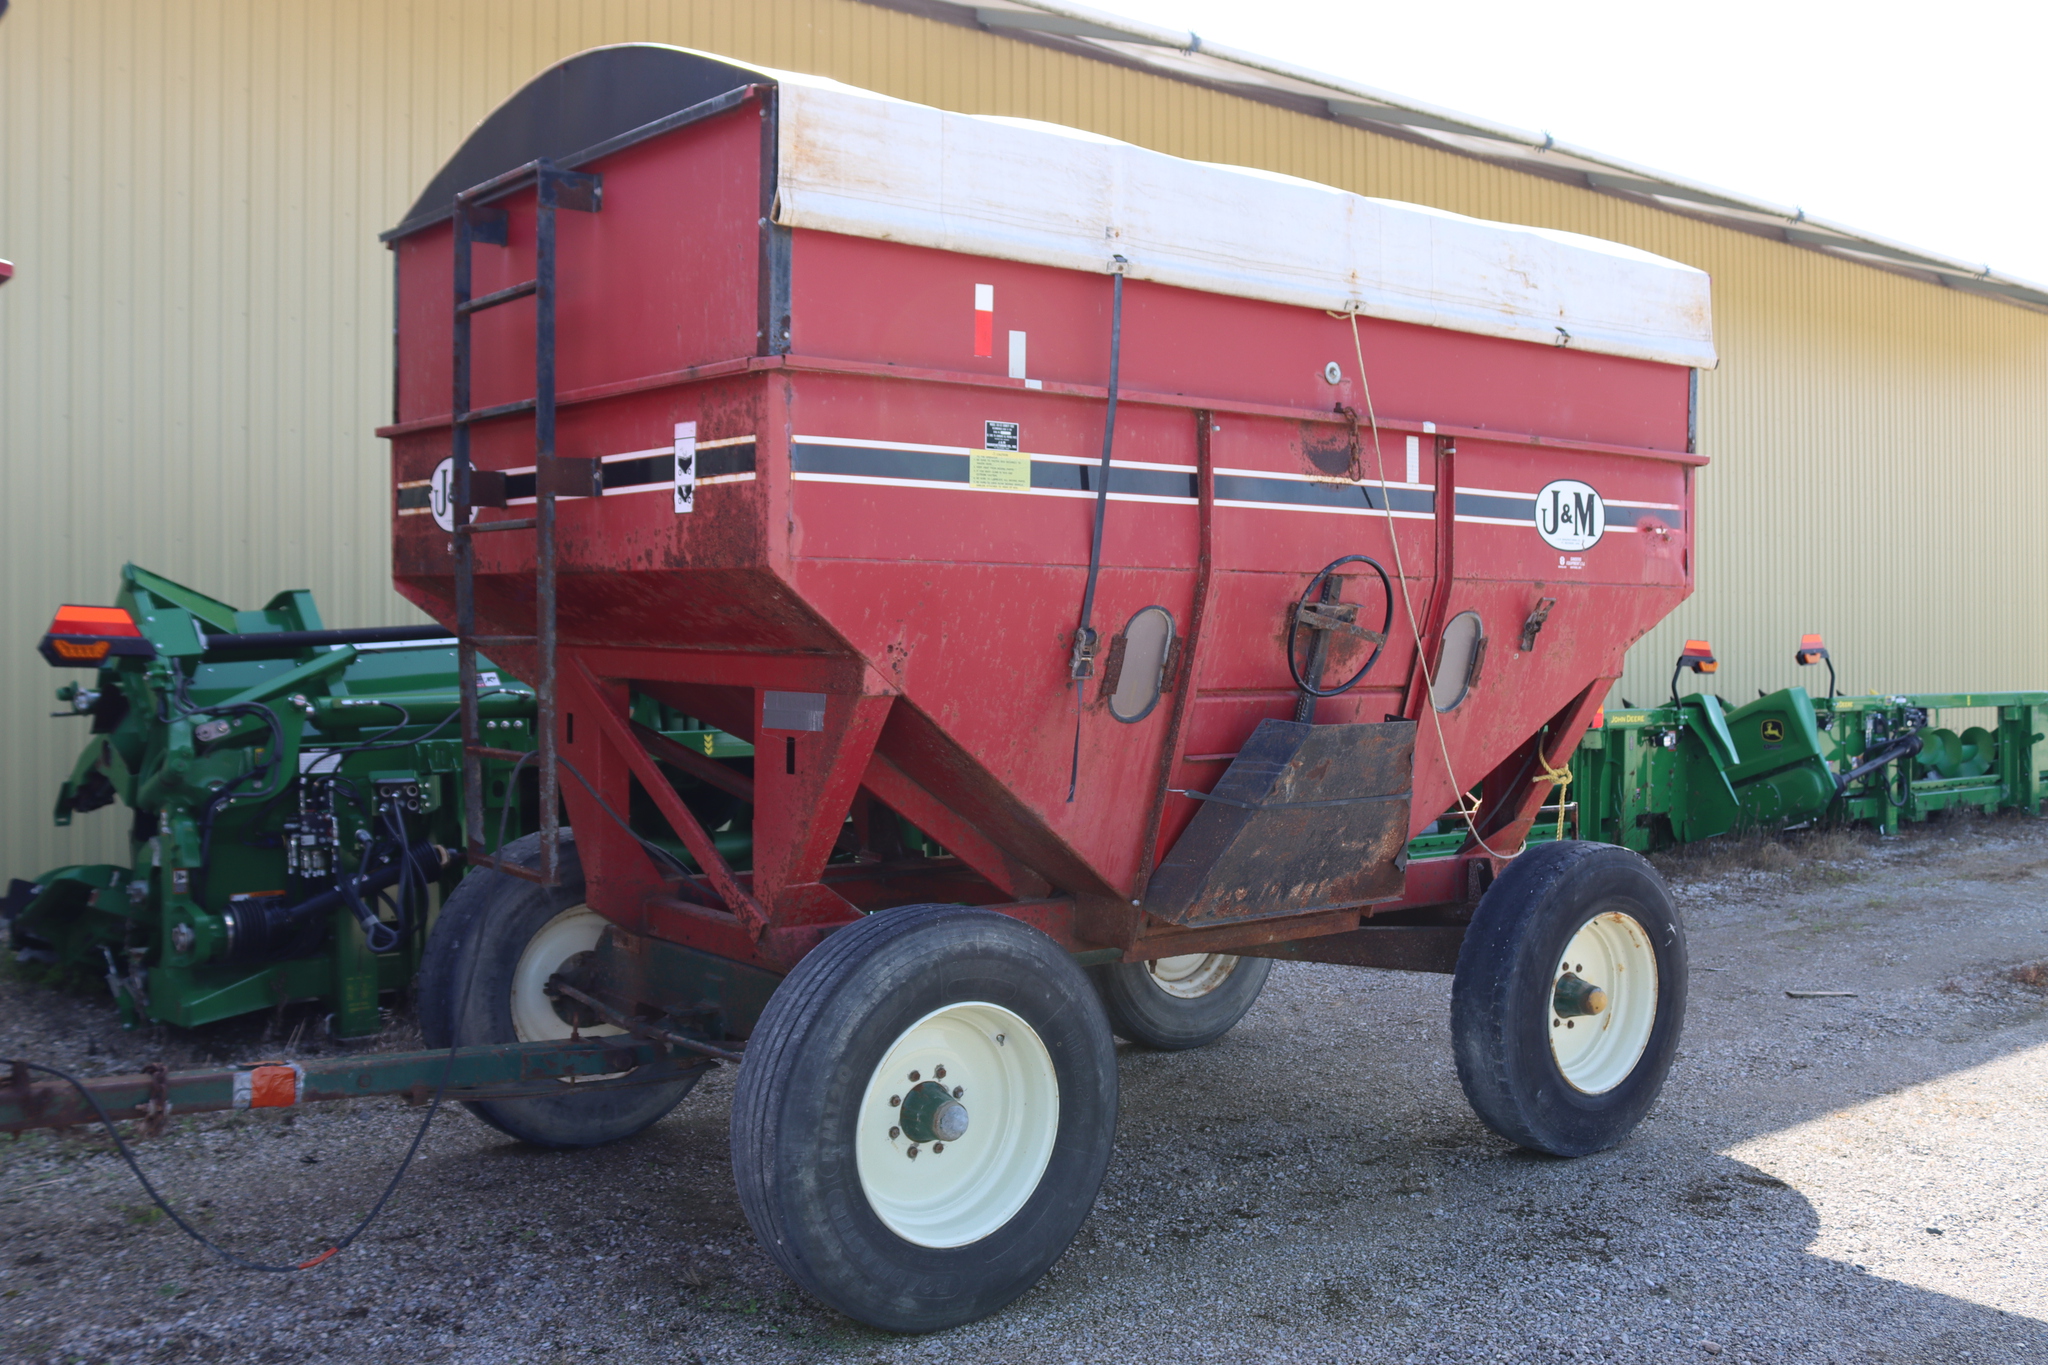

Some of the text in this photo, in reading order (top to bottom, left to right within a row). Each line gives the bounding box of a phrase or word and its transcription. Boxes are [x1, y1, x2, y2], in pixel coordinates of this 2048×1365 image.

[1541, 490, 1596, 537] J&M
[1611, 714, 1645, 723] JOHN DEERE
